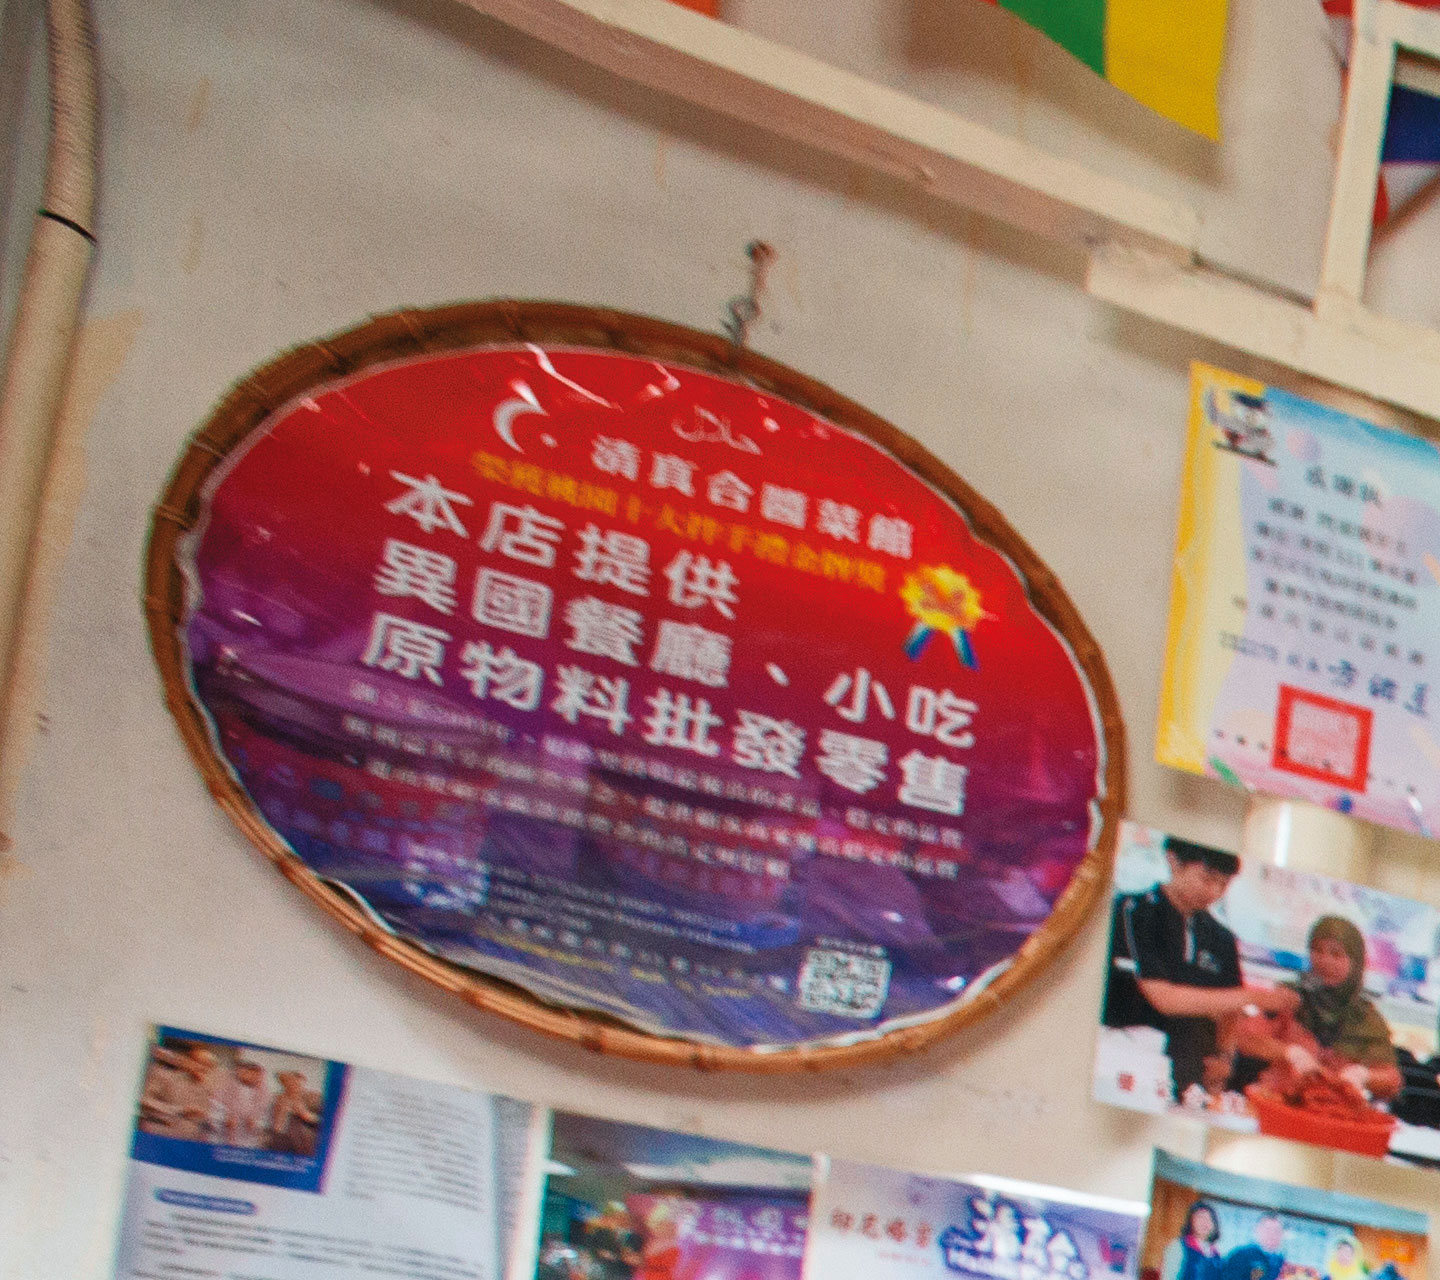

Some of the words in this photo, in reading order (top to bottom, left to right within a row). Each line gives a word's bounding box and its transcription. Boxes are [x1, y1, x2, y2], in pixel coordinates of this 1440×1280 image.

[373, 538, 979, 749] 異國餐廳、小吃
[383, 468, 740, 620] 本店提供
[360, 610, 970, 816] 原物料批發零售
